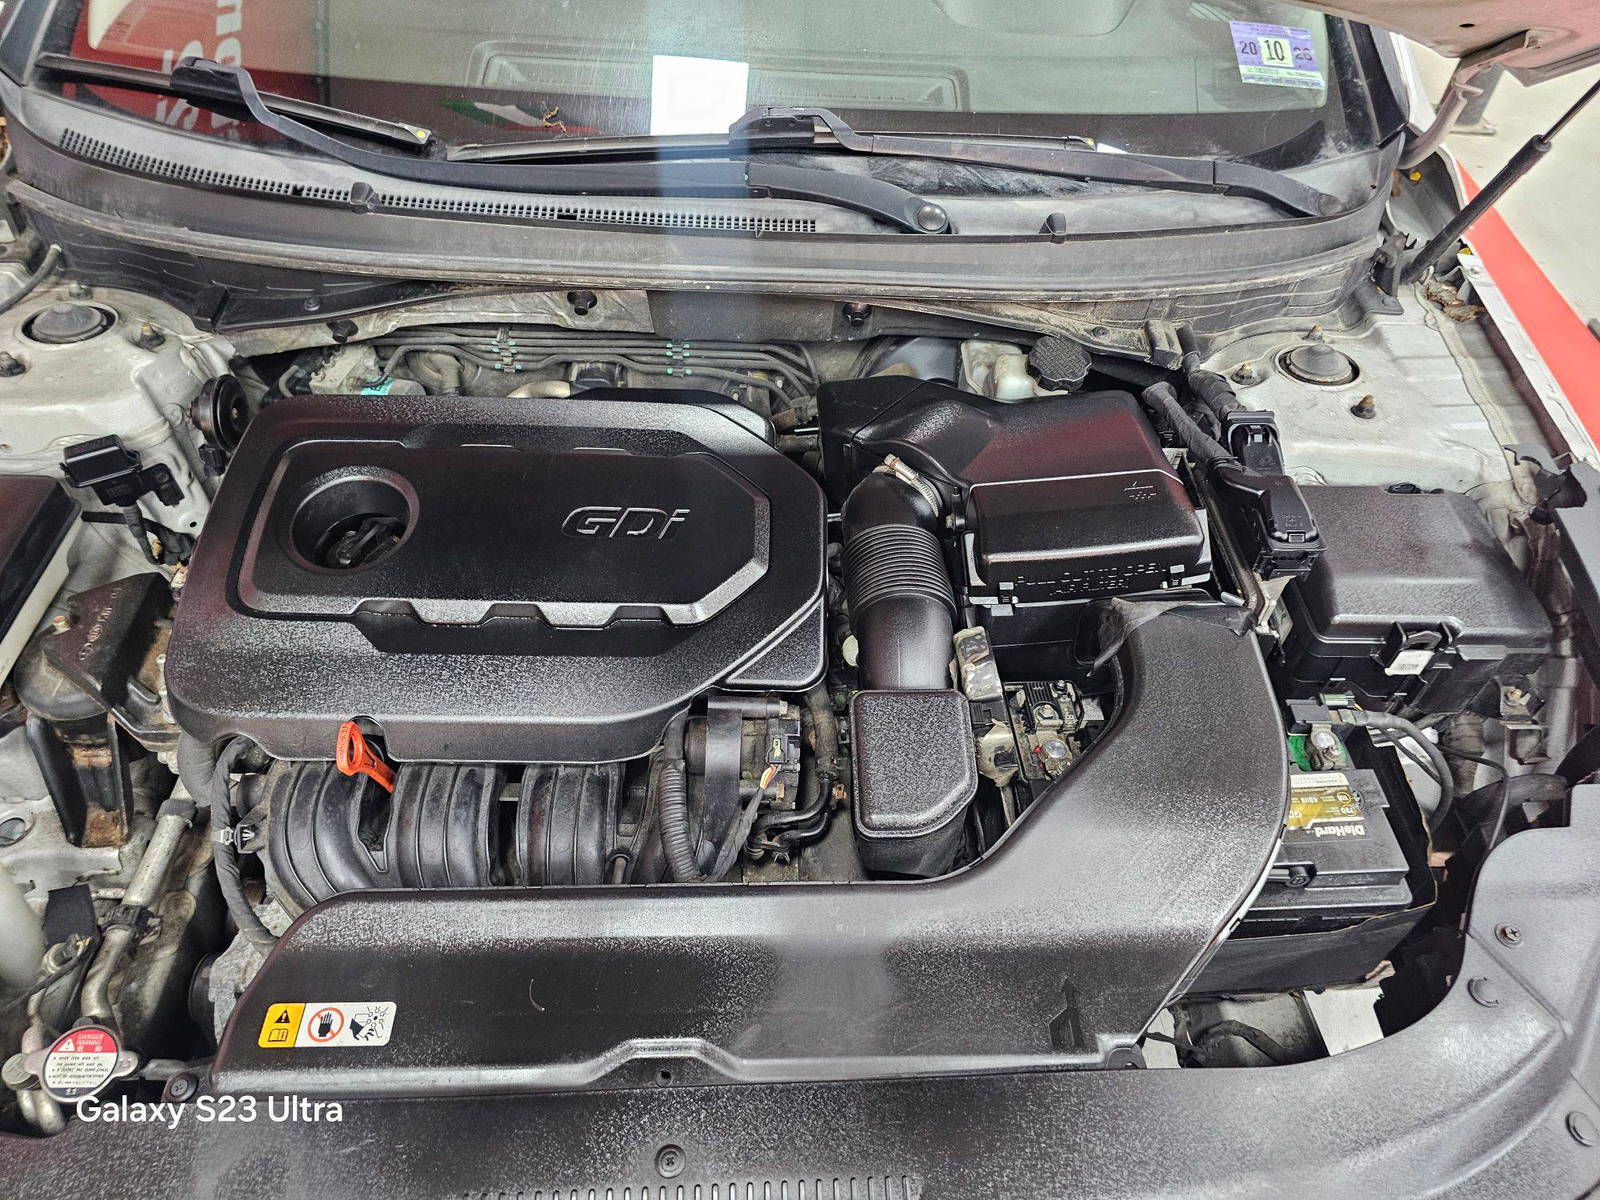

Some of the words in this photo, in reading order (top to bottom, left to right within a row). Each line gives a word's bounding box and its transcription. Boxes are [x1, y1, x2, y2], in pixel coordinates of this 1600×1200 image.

[1240, 41, 1258, 55] 20
[1264, 39, 1285, 61] 10
[1314, 825, 1365, 837] DieHard
